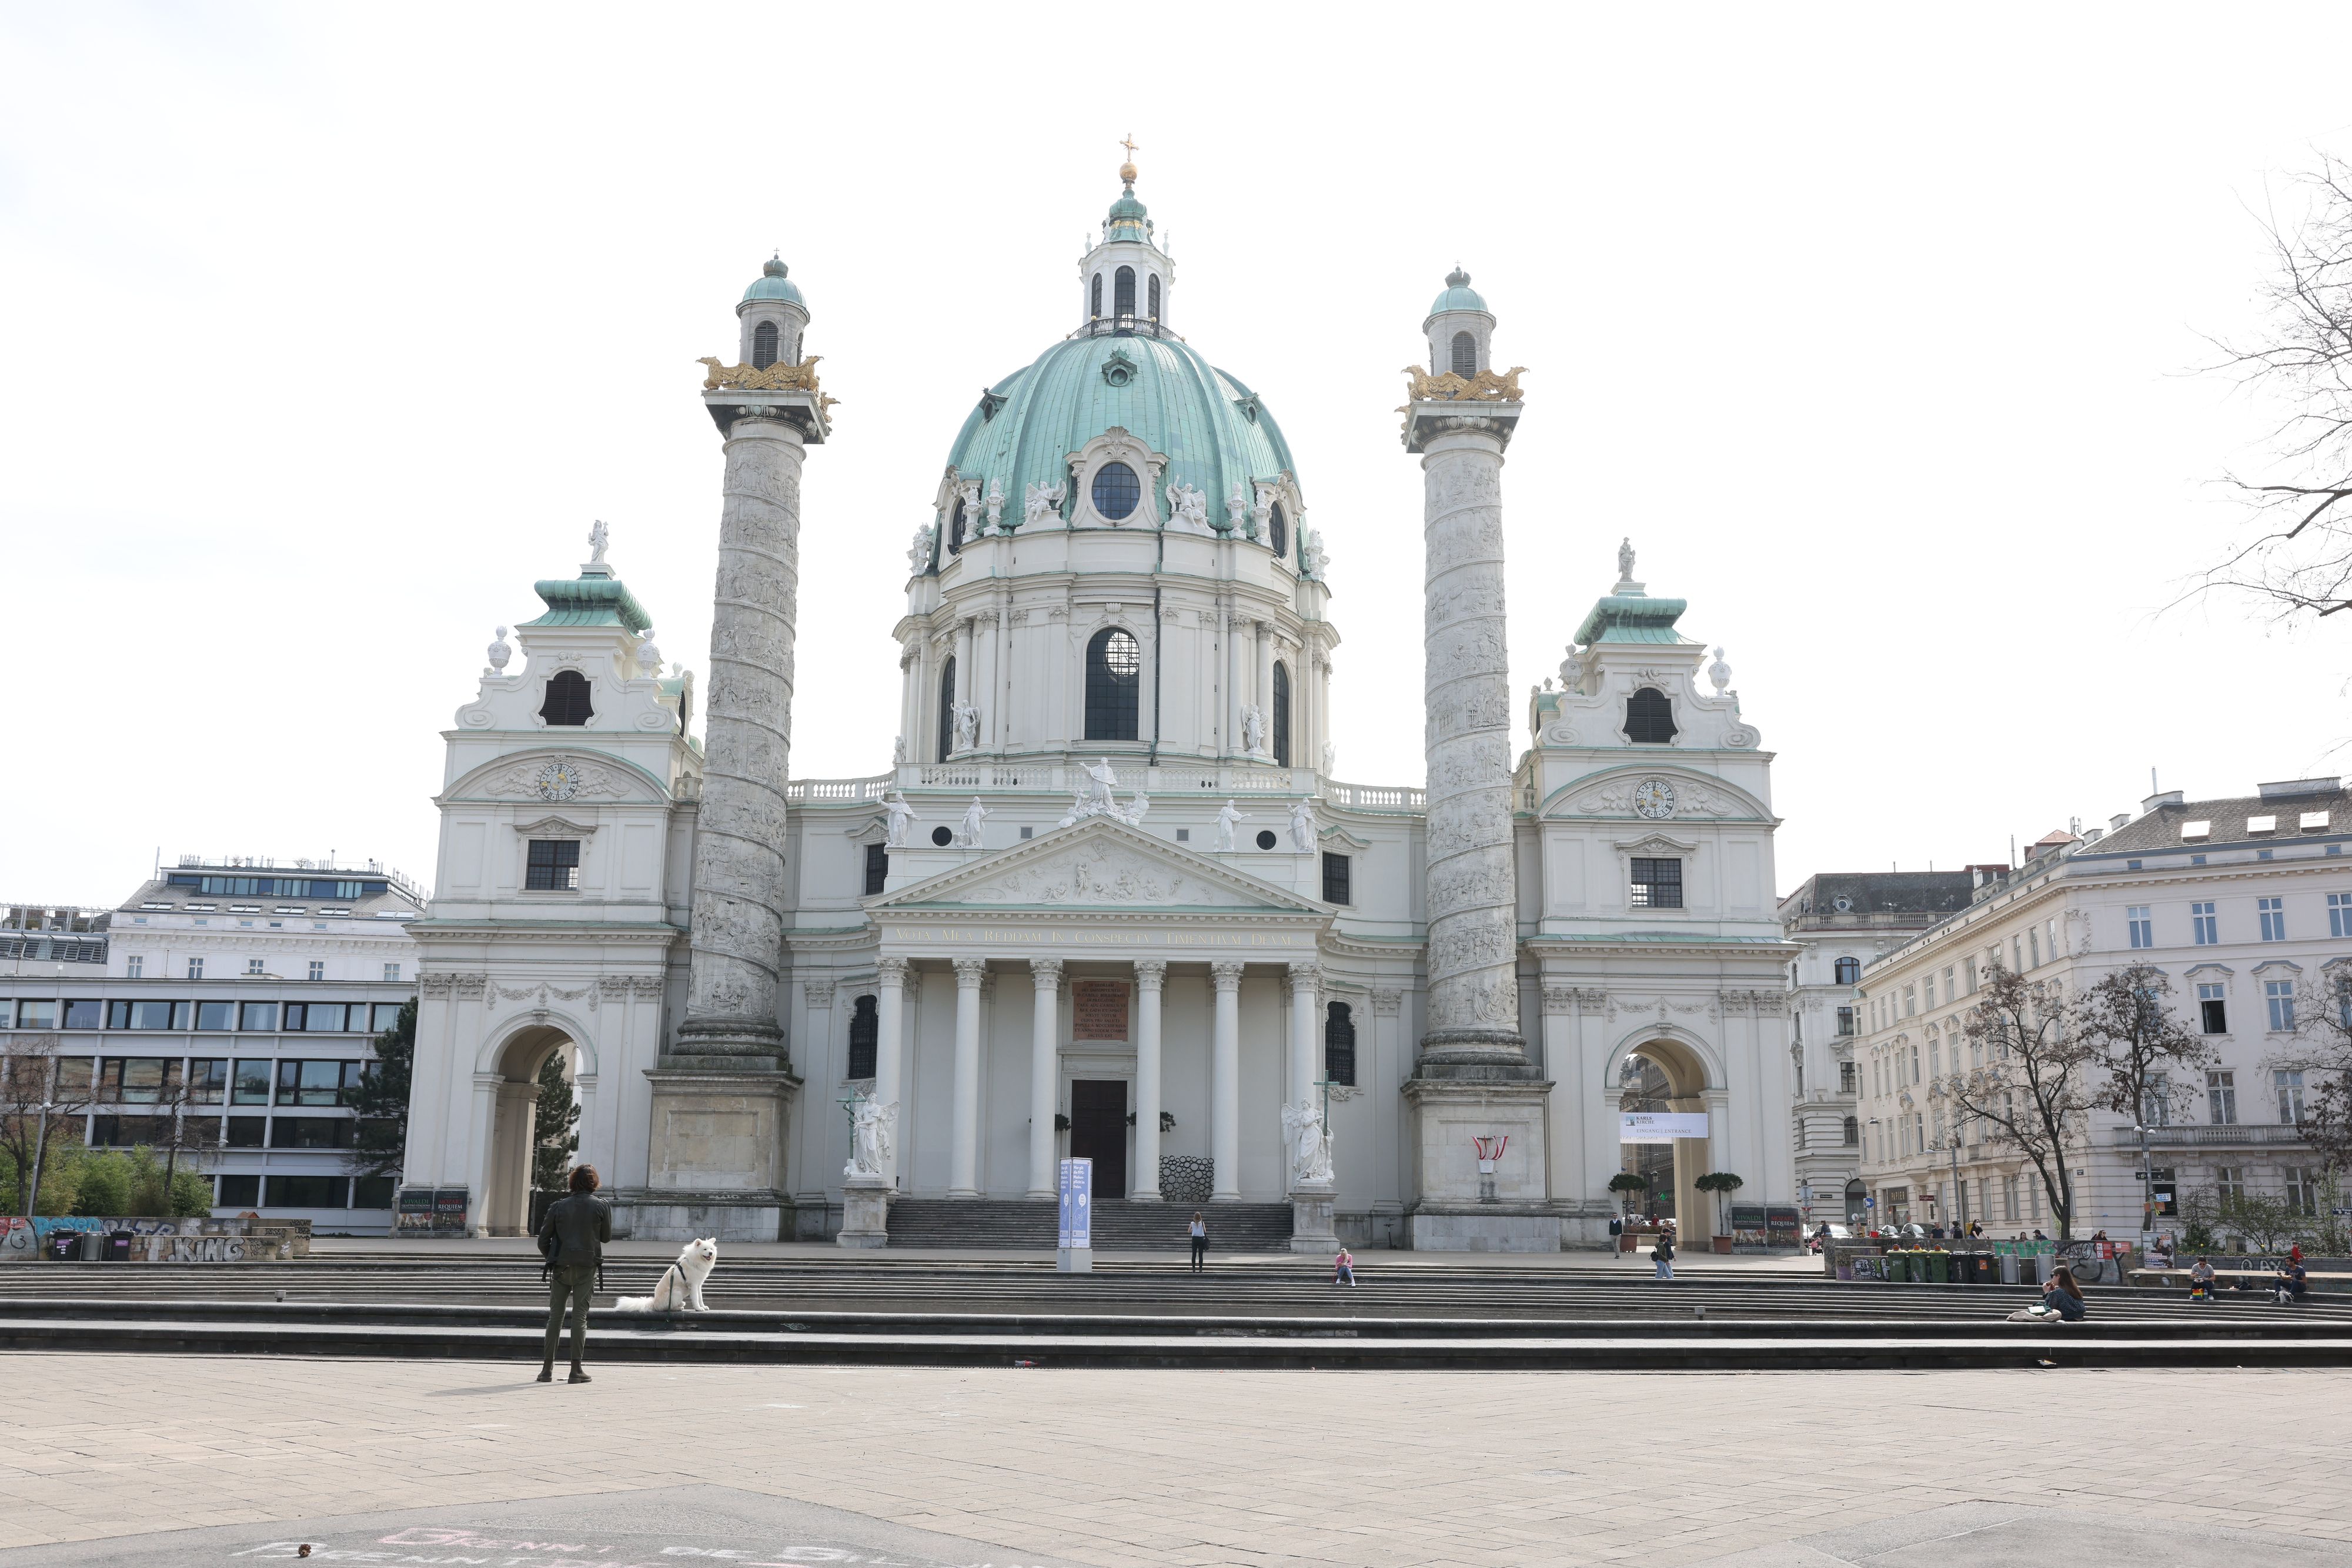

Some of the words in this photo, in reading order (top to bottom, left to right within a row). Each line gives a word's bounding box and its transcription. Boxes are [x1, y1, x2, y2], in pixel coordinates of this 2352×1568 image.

[897, 928, 931, 941] VOTA
[943, 929, 973, 941] MEA
[985, 930, 1041, 942] REDDAM
[1052, 931, 1064, 942] IN
[1164, 932, 1241, 945] TIMENTIVM
[1251, 933, 1291, 945] DEVM
[1891, 1191, 1905, 1201] PAPIER
